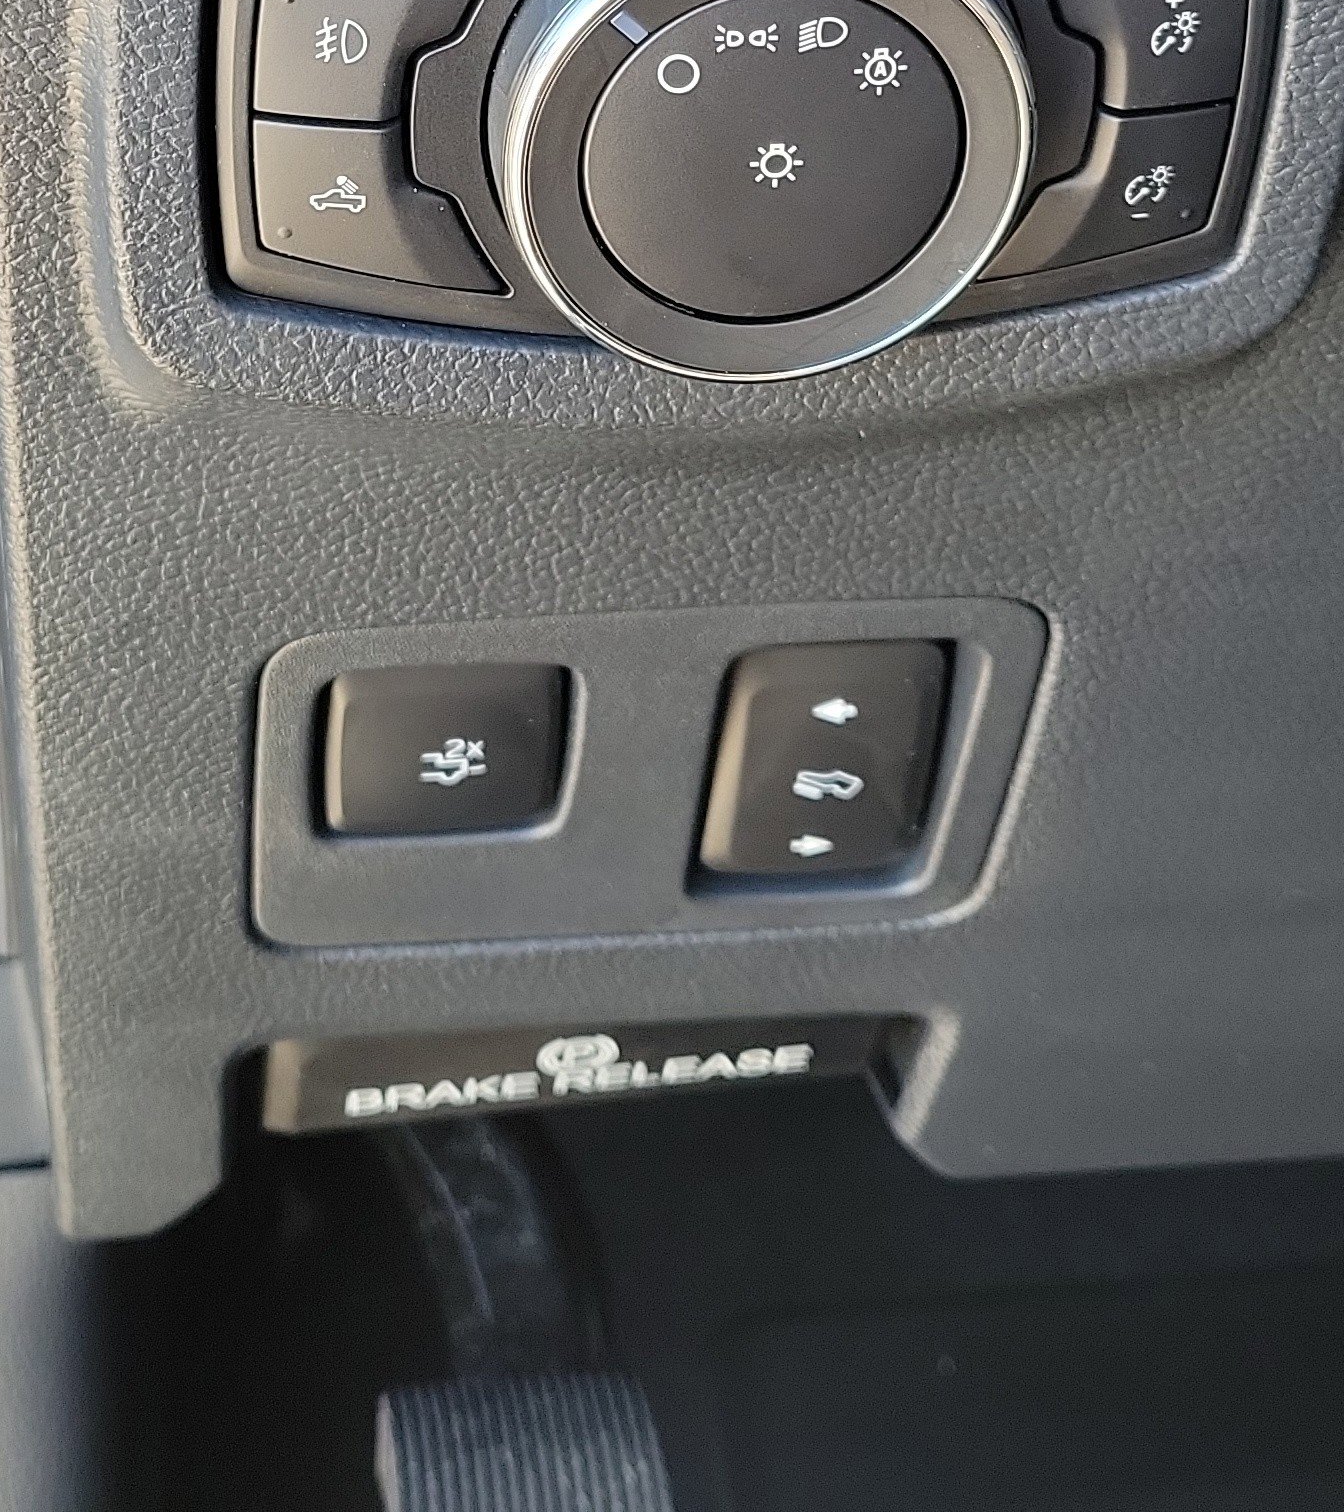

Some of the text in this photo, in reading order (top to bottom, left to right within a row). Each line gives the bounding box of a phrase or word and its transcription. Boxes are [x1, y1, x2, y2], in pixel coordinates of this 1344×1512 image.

[873, 60, 888, 78] A
[344, 1043, 815, 1117] BRAKE RELEASE
